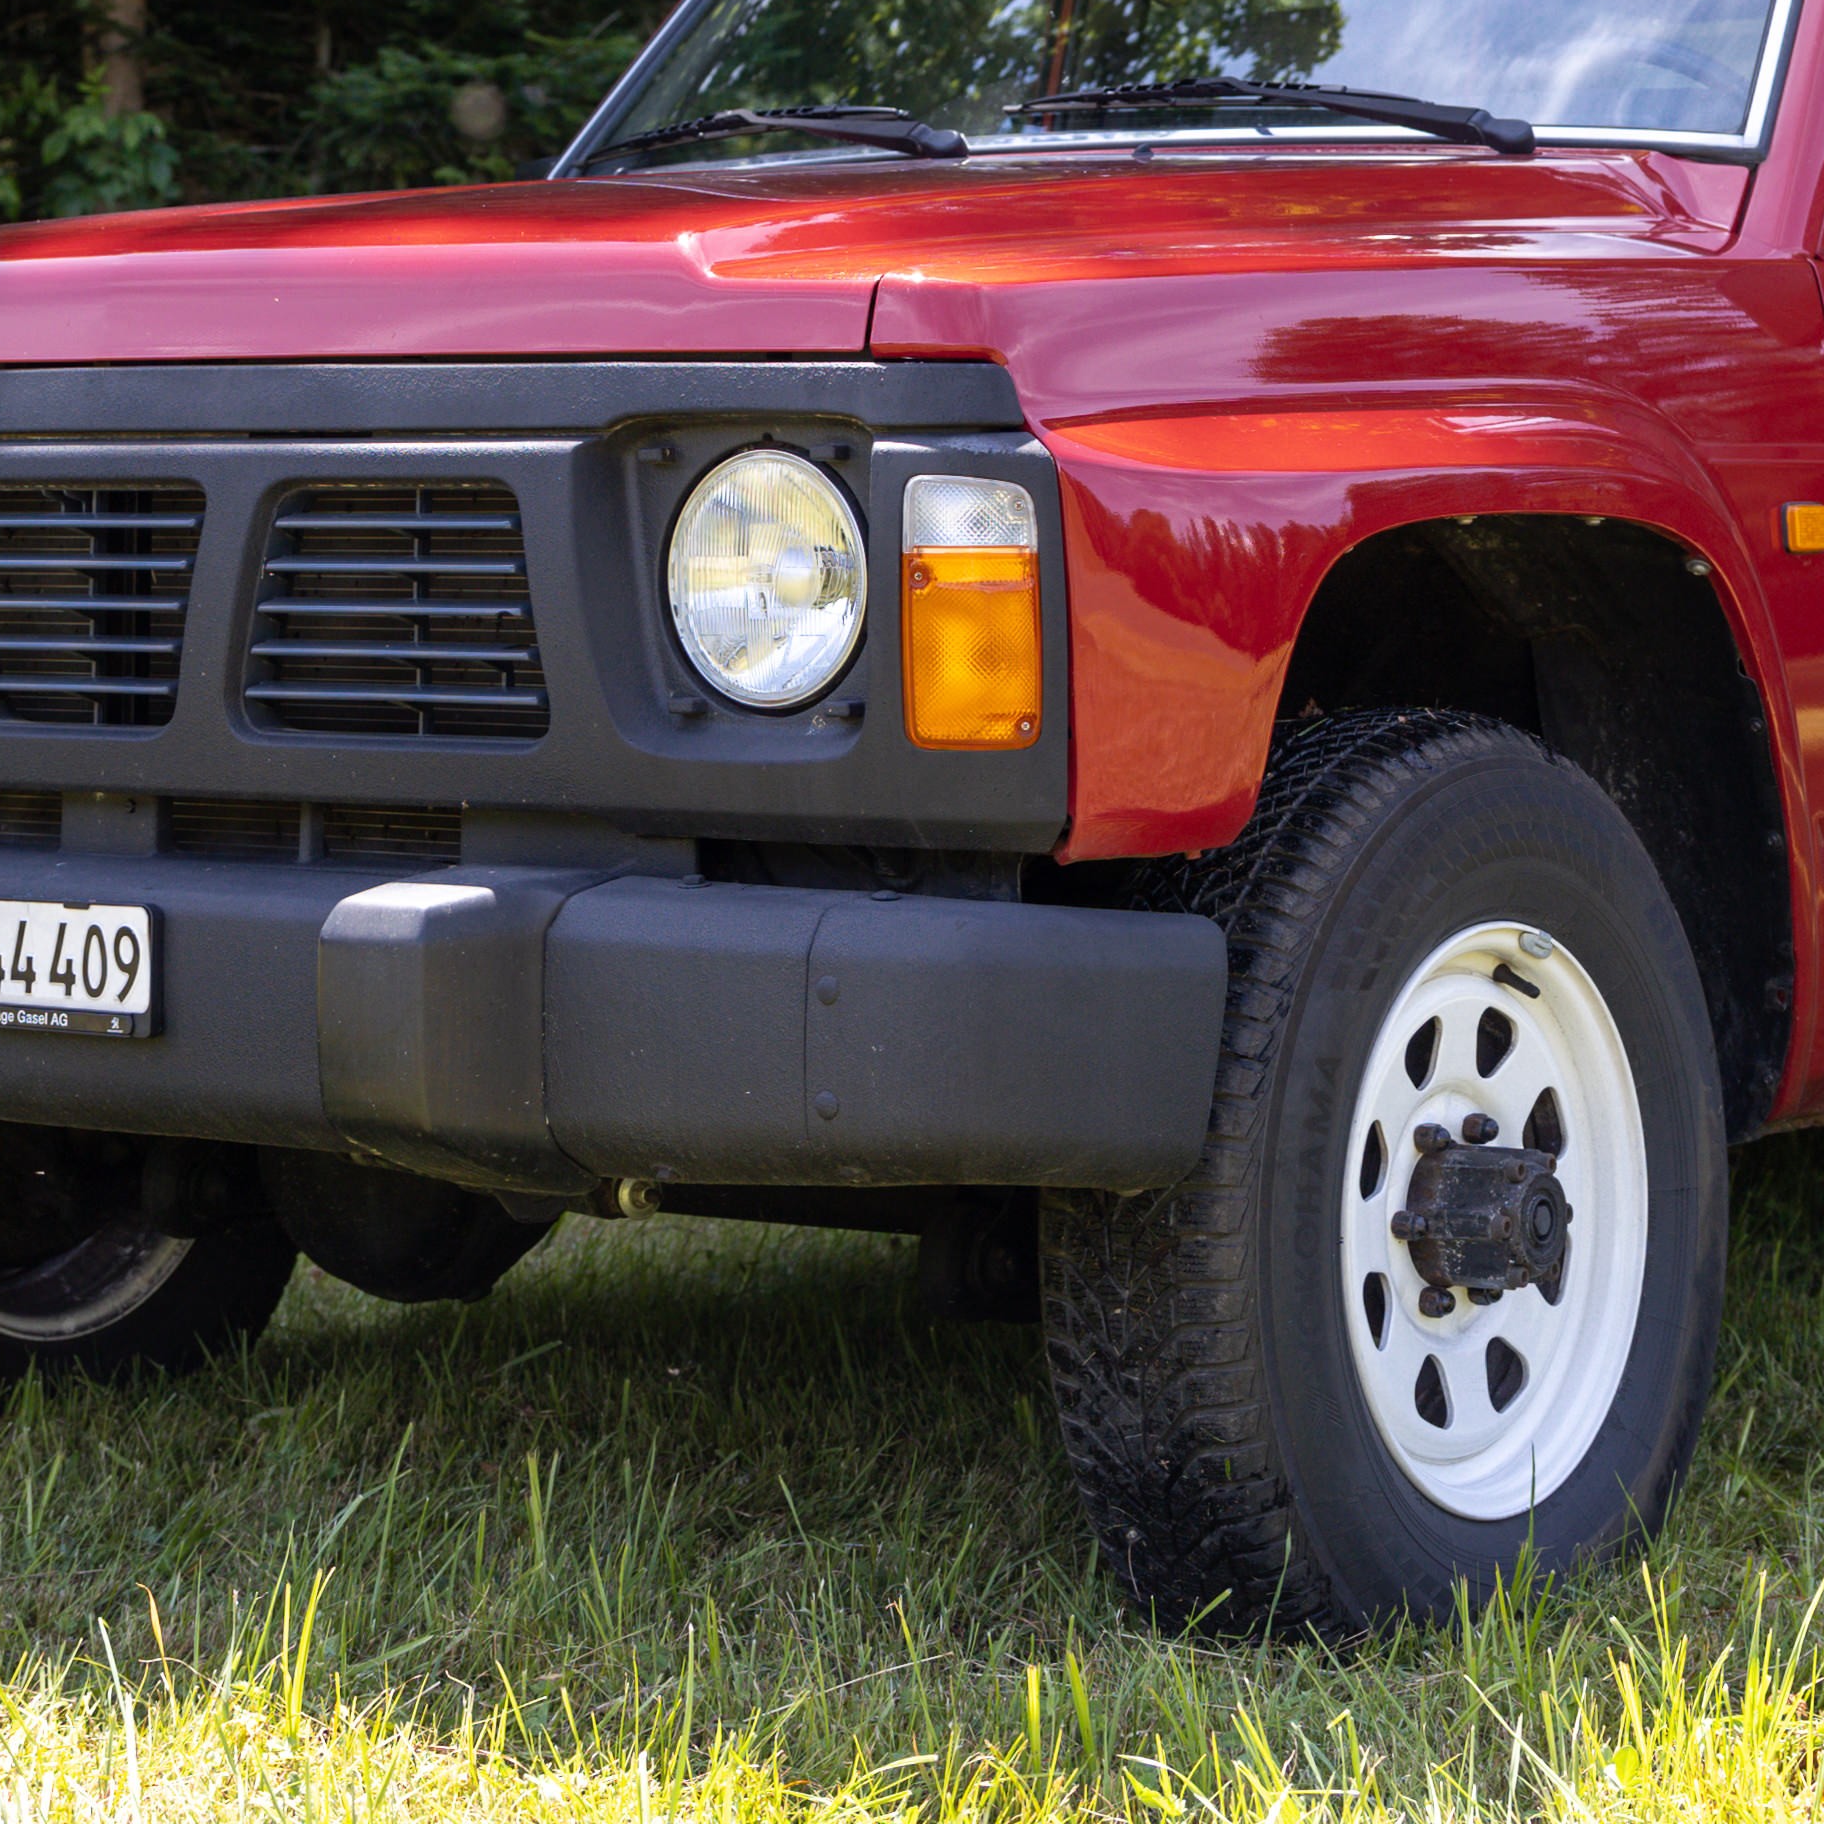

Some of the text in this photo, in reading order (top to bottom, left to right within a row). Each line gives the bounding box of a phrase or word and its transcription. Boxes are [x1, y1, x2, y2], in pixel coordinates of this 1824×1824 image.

[17, 1009, 48, 1025] Gasel
[50, 1012, 68, 1026] AG
[1293, 1056, 1342, 1366] OKOHAMA
